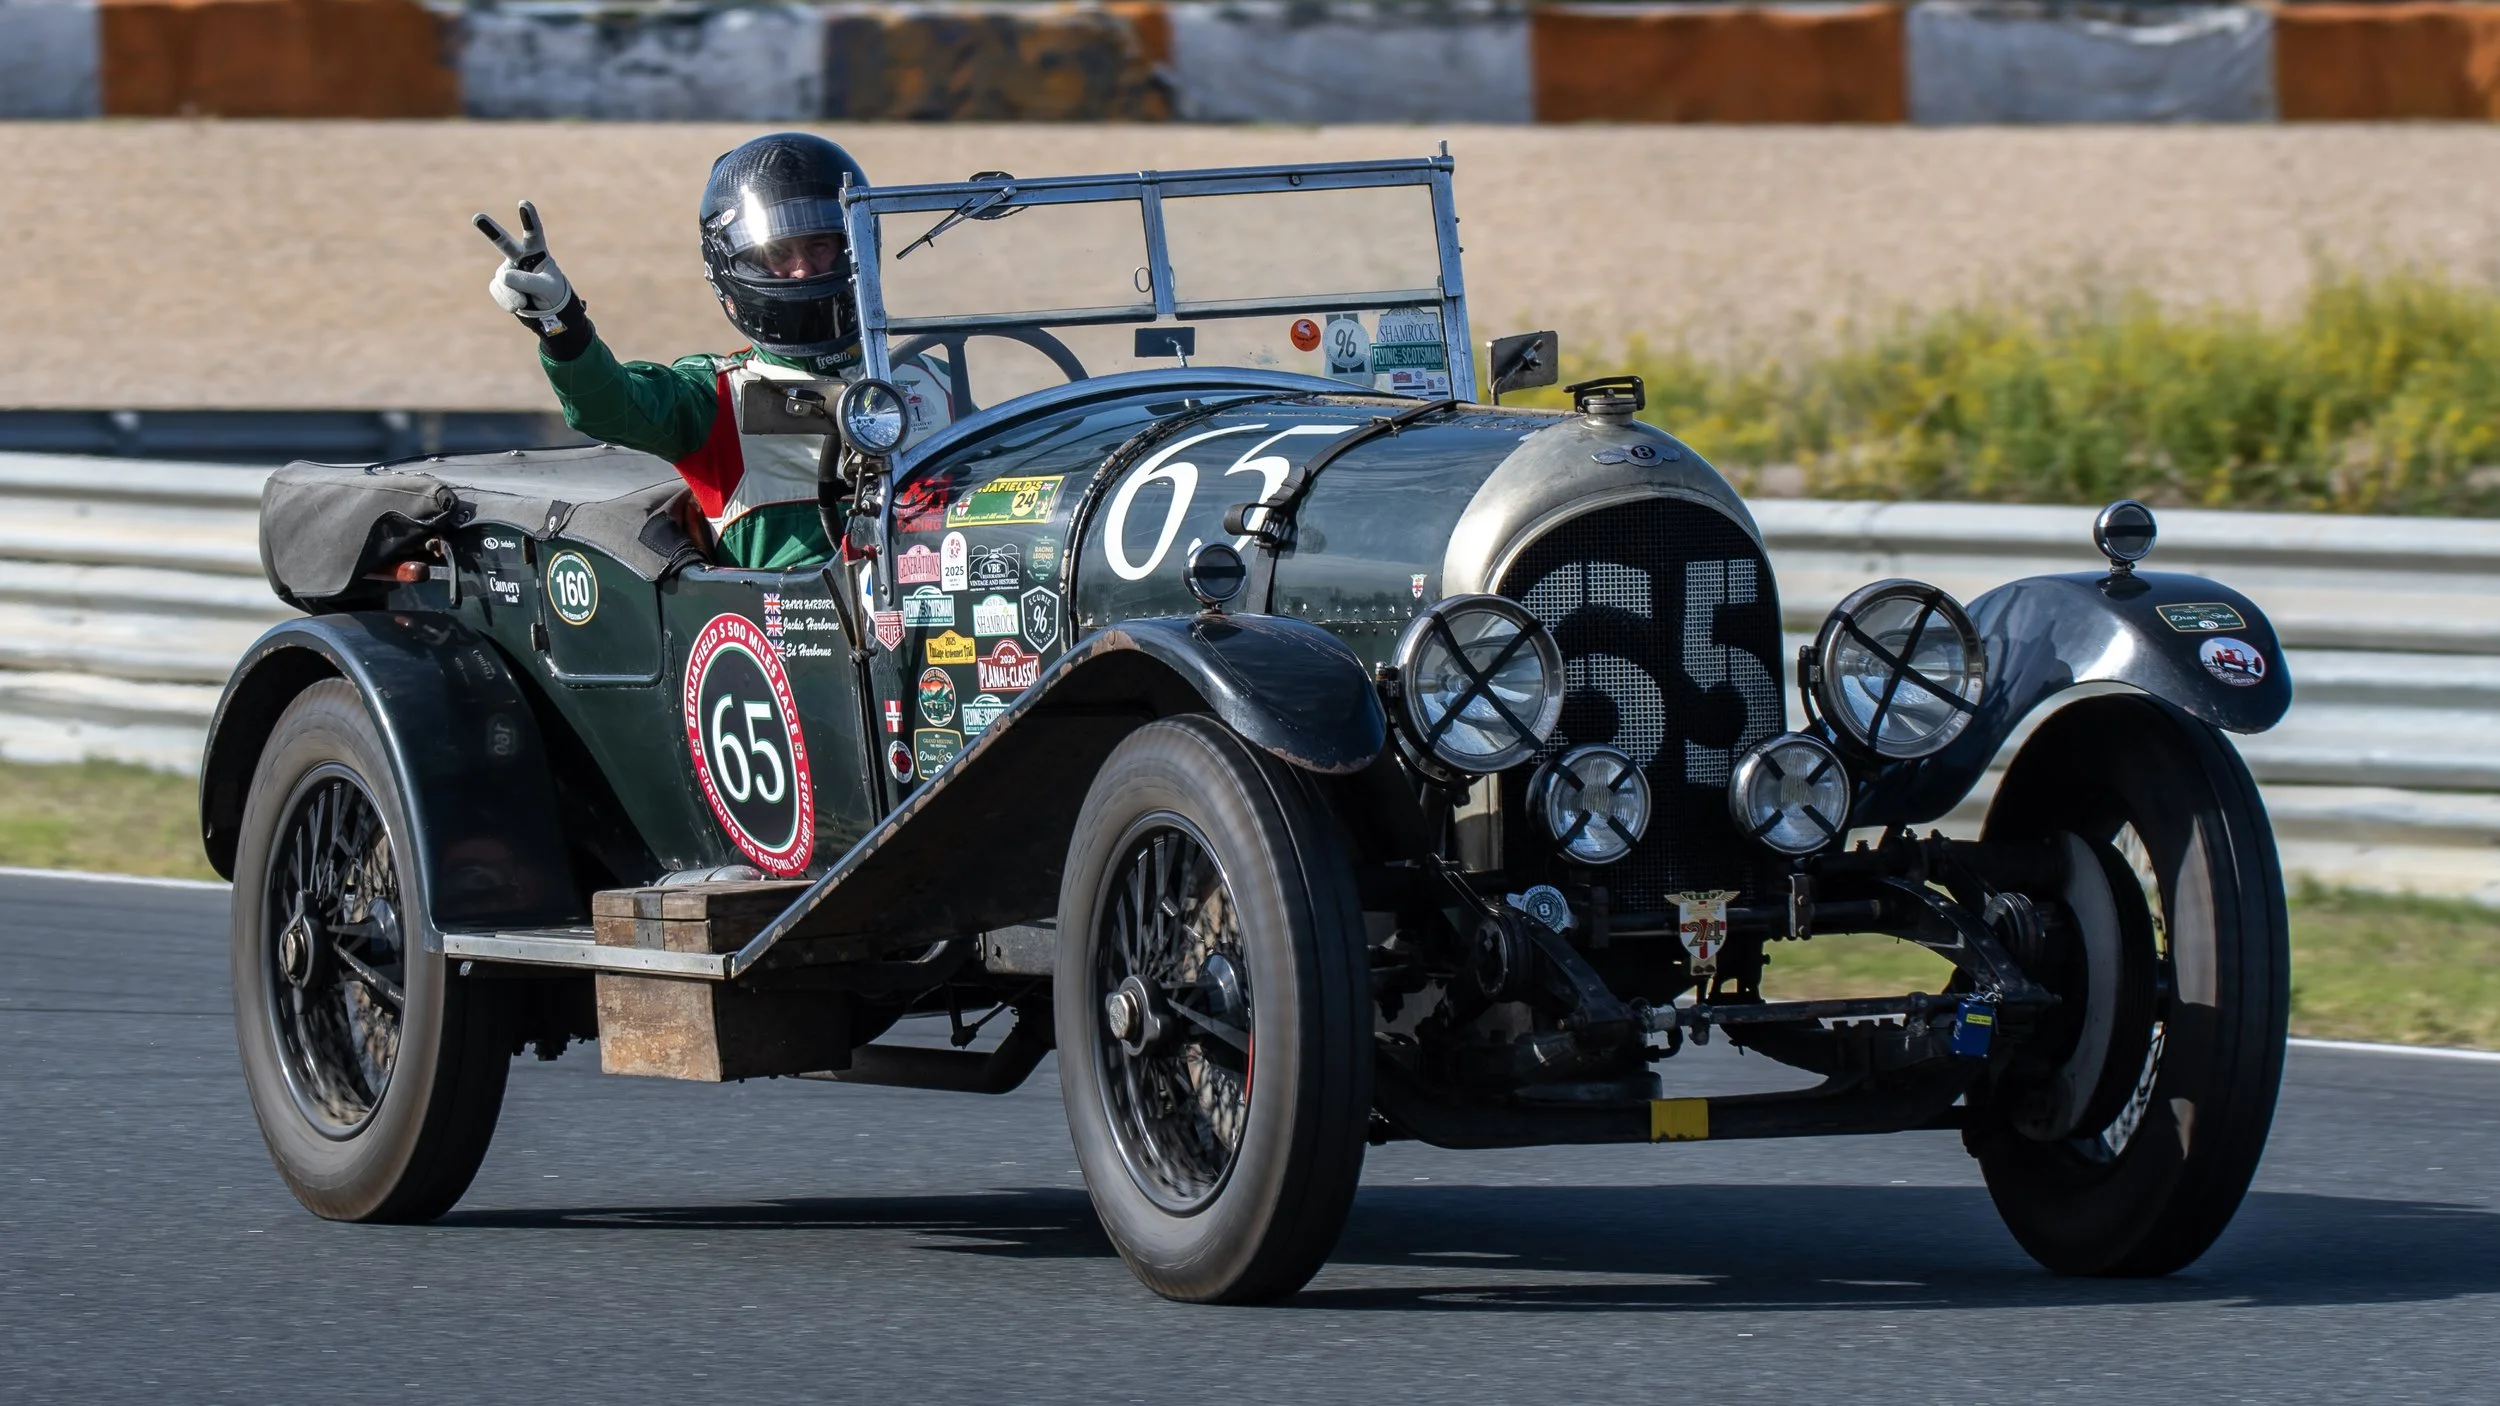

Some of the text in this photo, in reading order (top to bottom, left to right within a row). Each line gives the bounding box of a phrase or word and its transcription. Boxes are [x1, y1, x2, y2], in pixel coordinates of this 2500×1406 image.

[1380, 323, 1436, 342] SHAMROCK
[1335, 328, 1356, 358] 96
[1373, 346, 1442, 365] FLYING SCOTSMAN
[976, 480, 1043, 493] JAFIELD'S
[1014, 492, 1035, 509] 24
[1103, 423, 1359, 581] 65
[899, 555, 940, 579] GENERATIONS
[945, 565, 965, 577] 2025
[987, 563, 1001, 574] VBE
[556, 570, 590, 607] 160
[804, 599, 836, 610] HARBORN
[1028, 594, 1052, 607] ECURIE
[783, 616, 840, 634] Jackie Harborne
[976, 614, 1016, 634] SHAMROCK
[1033, 605, 1047, 633] 96
[786, 642, 832, 657] Ed Harborne
[1000, 655, 1016, 664] 2026
[687, 621, 799, 736] BENJAFIELD S 500 MILES RACE
[980, 659, 1039, 688] PLANAI-CLASSIC
[711, 693, 785, 804] 65
[700, 767, 811, 870] CIRCUITO DO ESTORIL 27TH SEPT 2026
[1686, 920, 1724, 947] 24
